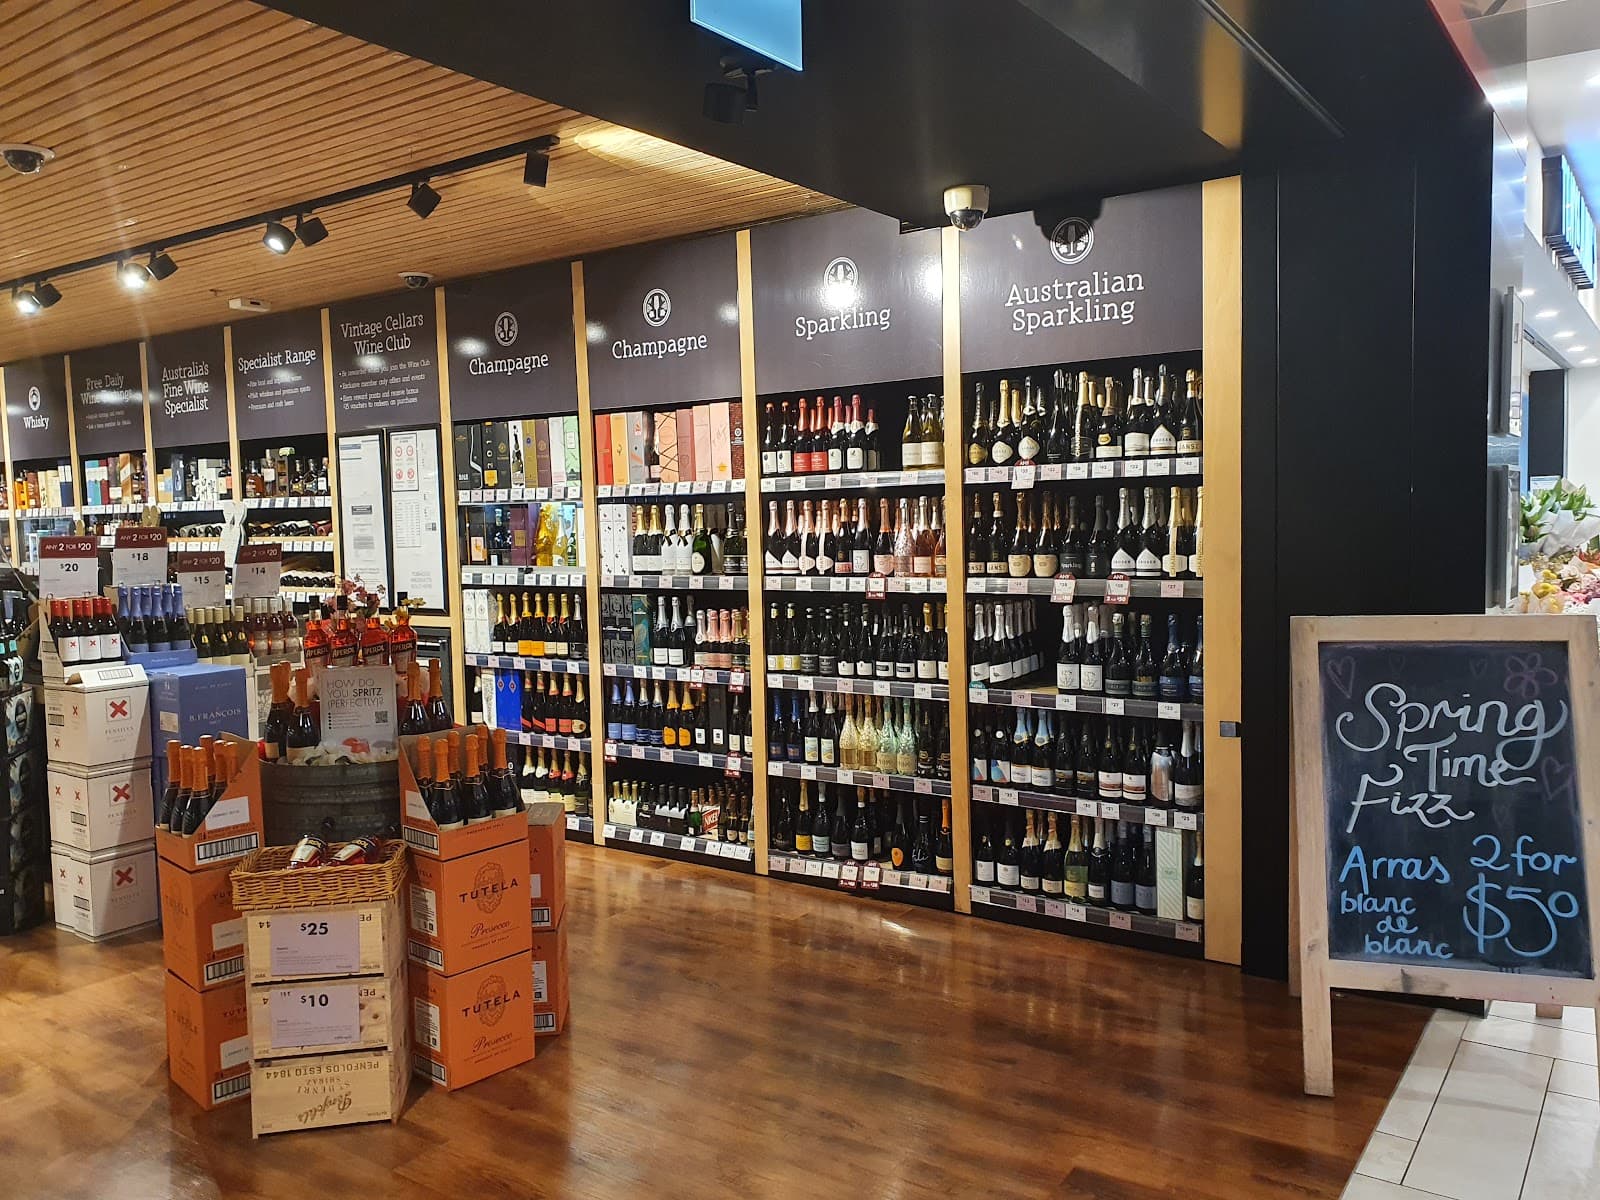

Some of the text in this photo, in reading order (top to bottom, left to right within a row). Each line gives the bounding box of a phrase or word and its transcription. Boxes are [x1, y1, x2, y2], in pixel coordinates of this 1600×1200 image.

[1004, 271, 1145, 308] Australian
[340, 312, 424, 338] Vintage Cellars
[794, 307, 891, 340] Sparkling
[1011, 297, 1136, 336] Sparkling
[354, 333, 411, 355] Wine Club
[612, 334, 708, 360] Champagne
[162, 360, 209, 382] Australia's
[238, 349, 317, 374] Specialist Range
[469, 352, 549, 376] Champagne
[86, 373, 124, 390] Free Daily
[163, 379, 209, 398] Fine Wine
[80, 391, 101, 405] Wine
[165, 395, 209, 418] Specialist
[23, 415, 50, 432] Whisky
[58, 542, 65, 550] 2
[78, 542, 92, 550] $20
[119, 534, 132, 542] ANY
[132, 533, 138, 541] 2
[149, 532, 162, 541] $20
[132, 552, 149, 561] $18
[192, 557, 199, 566] 2
[209, 556, 220, 565] $20
[266, 548, 278, 556] $20
[60, 563, 79, 572] $20
[251, 566, 266, 575] $14
[194, 576, 210, 584] $15
[332, 646, 355, 658] APEROL
[326, 678, 375, 689] HOW DO
[328, 688, 382, 699] YOU SPRITZ
[1336, 682, 1567, 771] Spring
[1403, 732, 1537, 792] Time
[1346, 764, 1475, 834] Fizz
[1469, 834, 1577, 877] 2 for
[1339, 845, 1450, 895] Arras
[459, 878, 518, 903] TUTELA
[1340, 892, 1416, 915] blanc
[1376, 916, 1418, 934] de
[1463, 873, 1579, 958] $50
[300, 922, 329, 936] $25
[1364, 935, 1453, 959] blanc
[300, 994, 329, 1008] $10
[461, 990, 520, 1017] TUTELA
[266, 1068, 292, 1080] 1844
[325, 1061, 379, 1074] PENFOLDS
